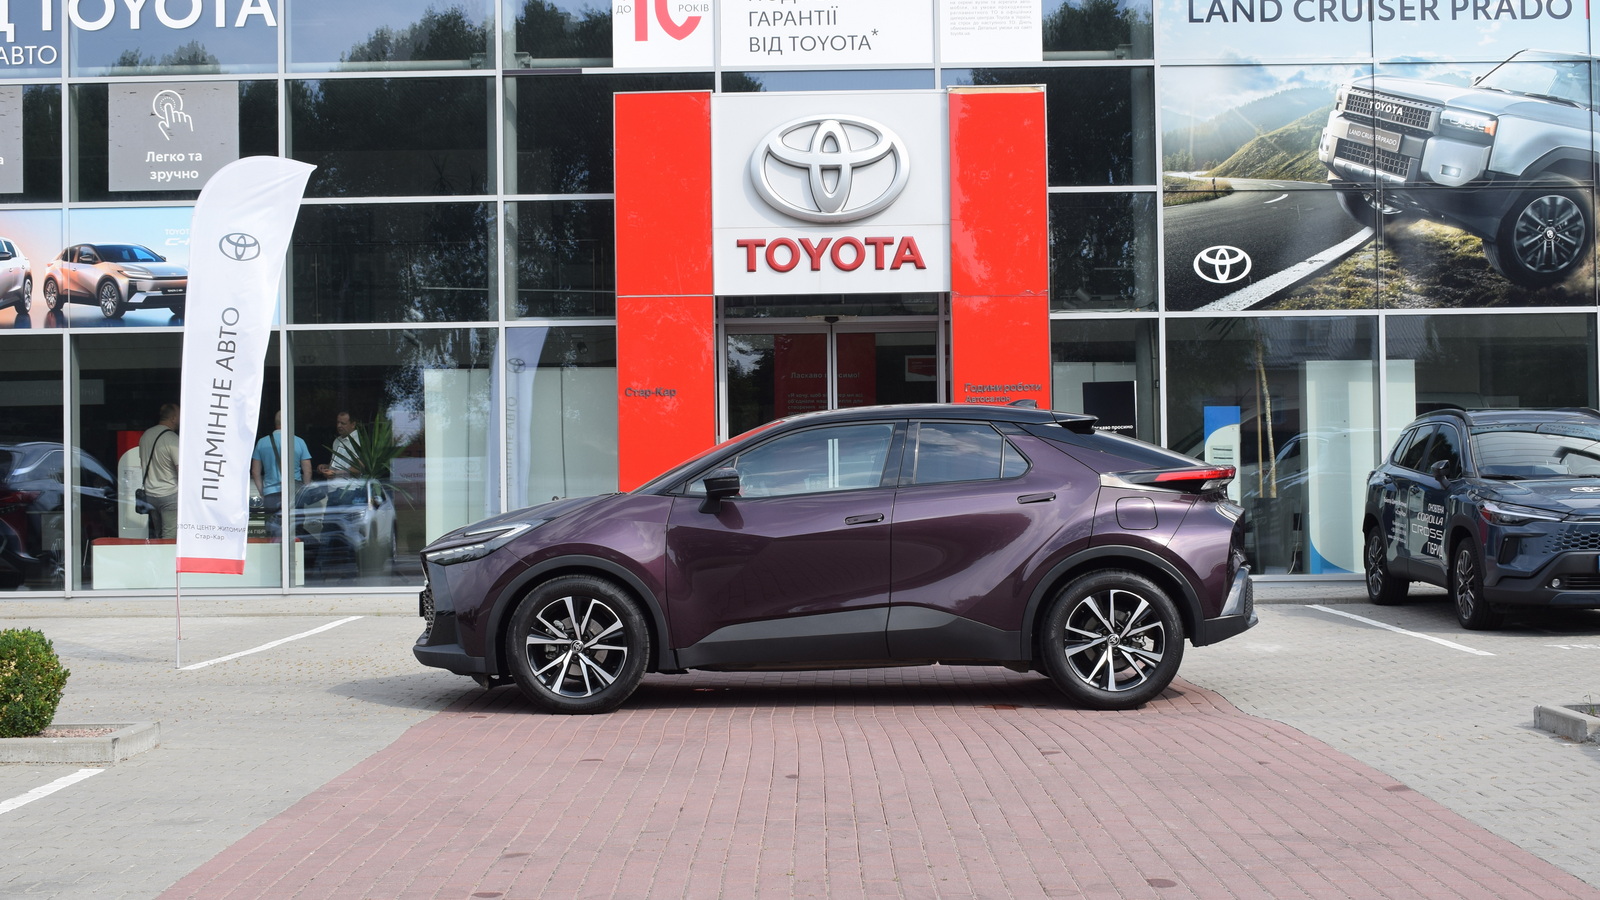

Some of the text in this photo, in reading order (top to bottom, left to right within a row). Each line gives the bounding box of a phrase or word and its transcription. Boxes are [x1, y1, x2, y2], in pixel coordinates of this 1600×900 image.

[616, 5, 632, 14] ДО
[678, 4, 710, 12] РОКІВ
[1187, 0, 1573, 23] LAND CRUISER PRADO
[749, 5, 839, 27] ГАРАНТІЇ
[749, 36, 783, 55] ВІД
[1369, 101, 1403, 116] TOYOTA
[1348, 128, 1362, 137] LAND
[145, 151, 203, 163] Легко та
[149, 170, 199, 182] зручно
[736, 236, 928, 273] TOYOTA
[624, 387, 677, 399] Стар-Кар
[964, 382, 1042, 394] Години роботи
[201, 306, 240, 501] ПІДМІННЕ АВТО
[965, 395, 1011, 403] Автосалон
[1417, 512, 1443, 526] COROLLA
[194, 533, 225, 541] Стар-Кар
[1412, 524, 1443, 540] CROSS
